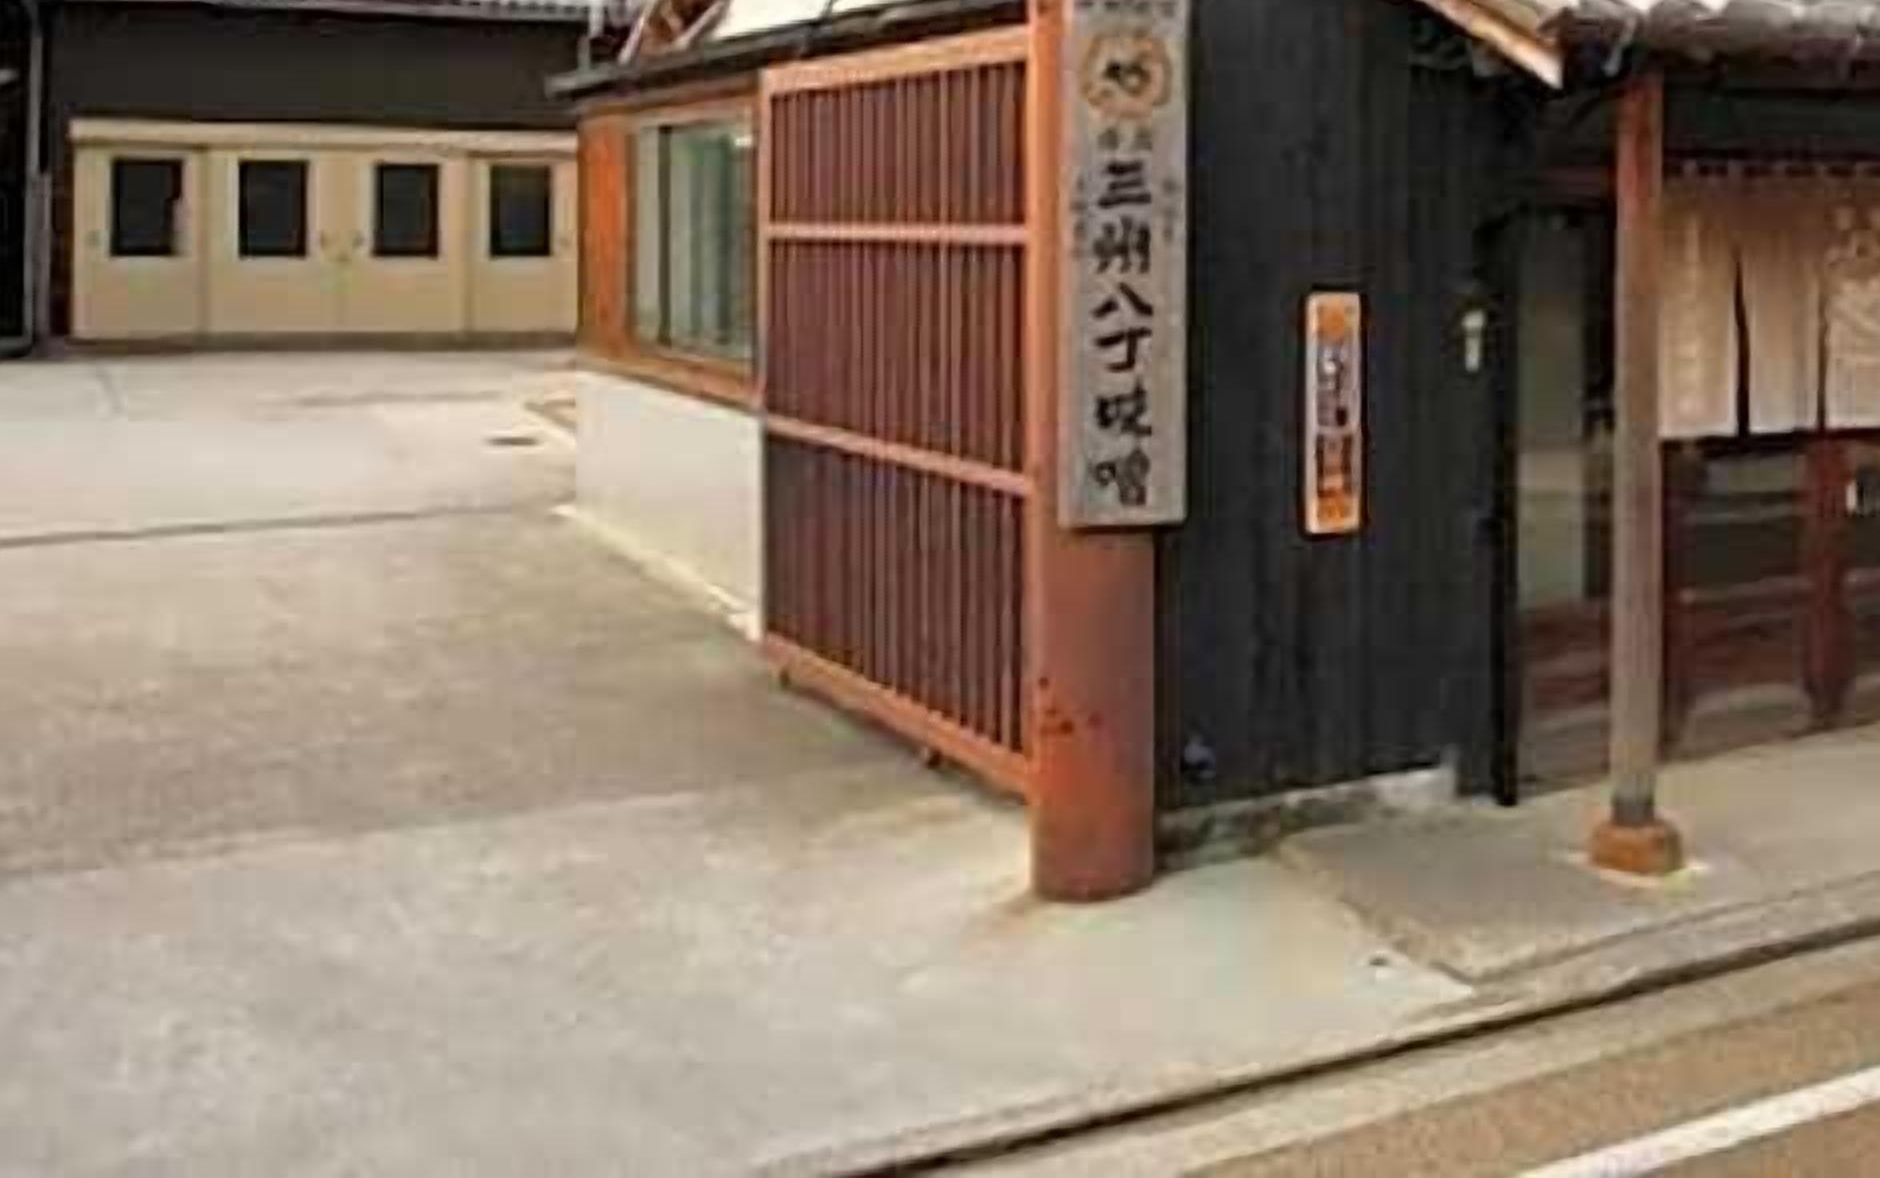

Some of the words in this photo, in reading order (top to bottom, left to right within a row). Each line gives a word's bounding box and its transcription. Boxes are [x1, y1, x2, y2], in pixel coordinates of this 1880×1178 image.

[1091, 162, 1154, 506] 三州八丁味噌
